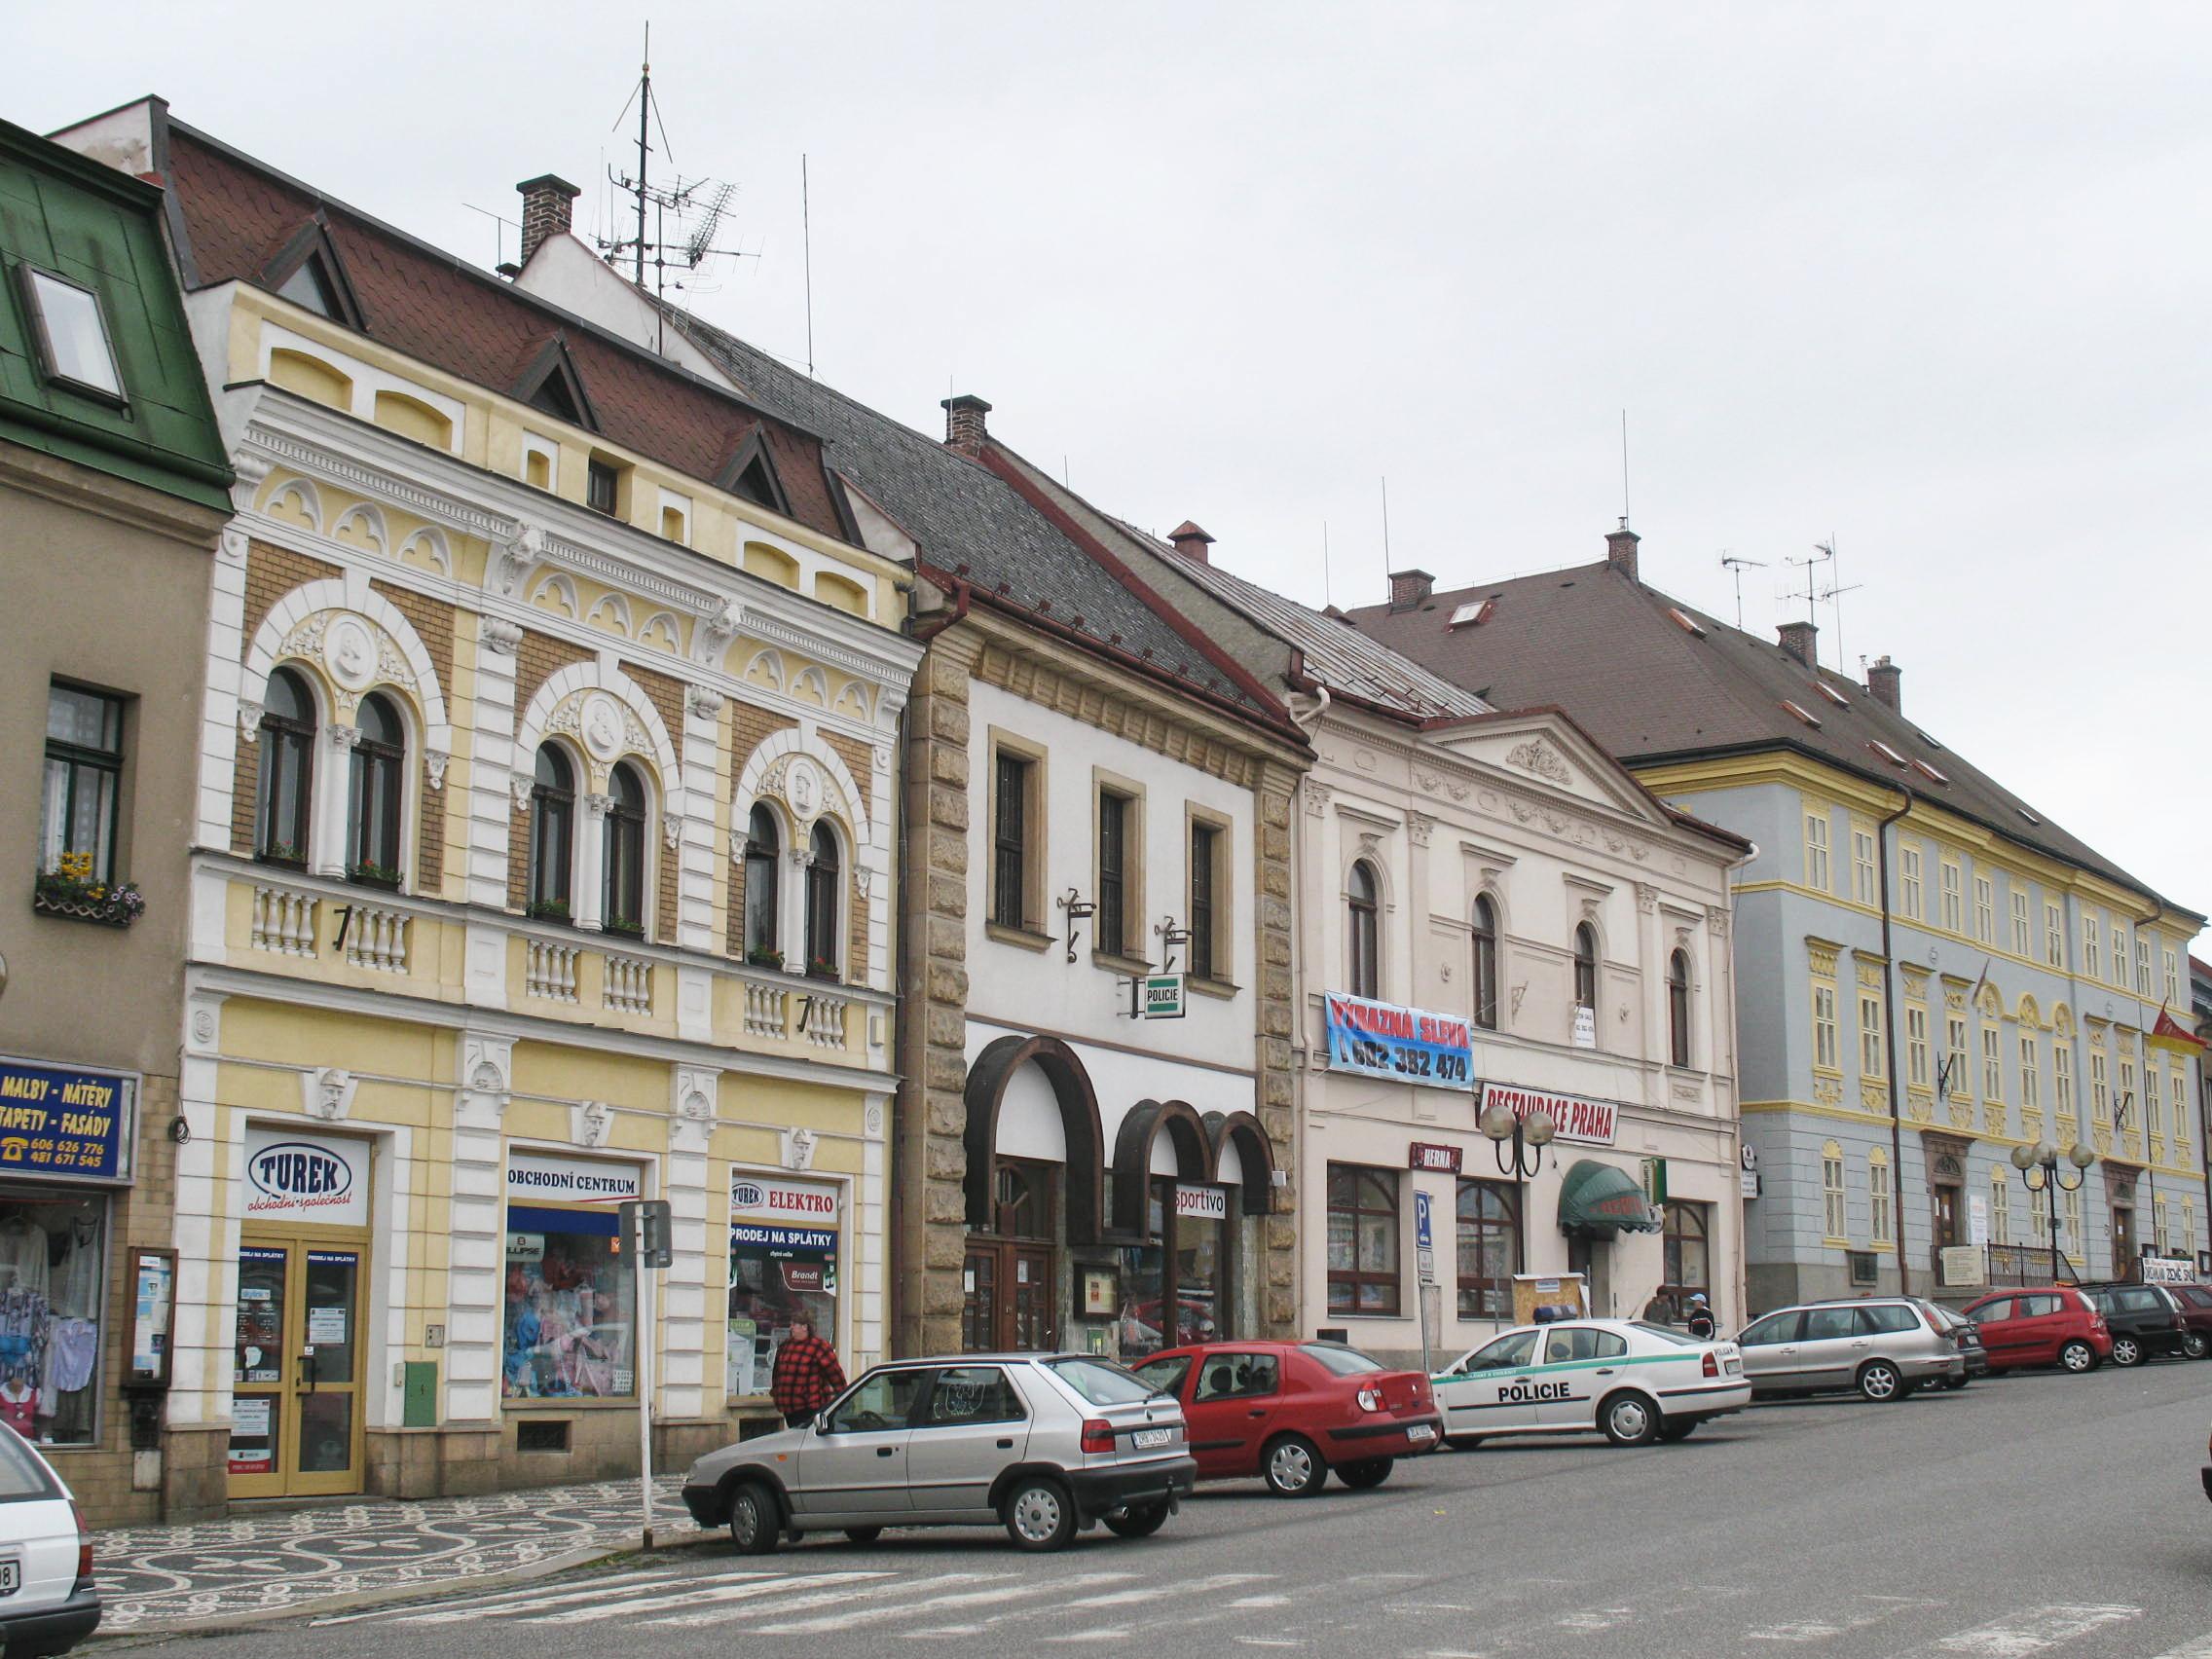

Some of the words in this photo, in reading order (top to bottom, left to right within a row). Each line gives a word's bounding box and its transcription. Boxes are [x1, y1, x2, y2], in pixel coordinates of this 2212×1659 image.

[1147, 989, 1178, 1002] POLICIE
[1330, 998, 1415, 1040] VÝRAZNÁ
[1419, 1016, 1469, 1049] SLEVA
[1352, 1040, 1389, 1070] 602
[1394, 1047, 1431, 1077] 382
[1436, 1053, 1466, 1082] 474
[0, 1076, 49, 1101] MALBY
[62, 1079, 113, 1108] NÁTĚRY
[0, 1106, 47, 1130] TAPETY
[60, 1110, 111, 1137] FASÁDY
[1569, 1101, 1612, 1138] PRAHA
[30, 1138, 54, 1150] 606
[57, 1140, 80, 1153] 626
[83, 1142, 104, 1155] 776
[30, 1152, 51, 1163] 481
[55, 1154, 76, 1165] 671
[79, 1155, 102, 1167] 545
[1423, 1149, 1451, 1168] HERNA
[260, 1154, 338, 1193] TUREK
[508, 1169, 573, 1188] OBCHODNÍ
[576, 1175, 635, 1194] CENTRUM
[298, 1192, 351, 1212] společnost
[732, 1188, 759, 1203] TUREK
[769, 1191, 833, 1213] ELEKTRO
[1176, 1190, 1224, 1212] sportivo
[1418, 1198, 1427, 1230] P
[730, 1227, 768, 1242] PRODEJ
[771, 1231, 786, 1243] NA
[788, 1231, 831, 1246] SPLÁTKY
[792, 1271, 818, 1280] Brandt
[1498, 1382, 1570, 1402] POLICIE
[0, 1567, 10, 1587] 8
